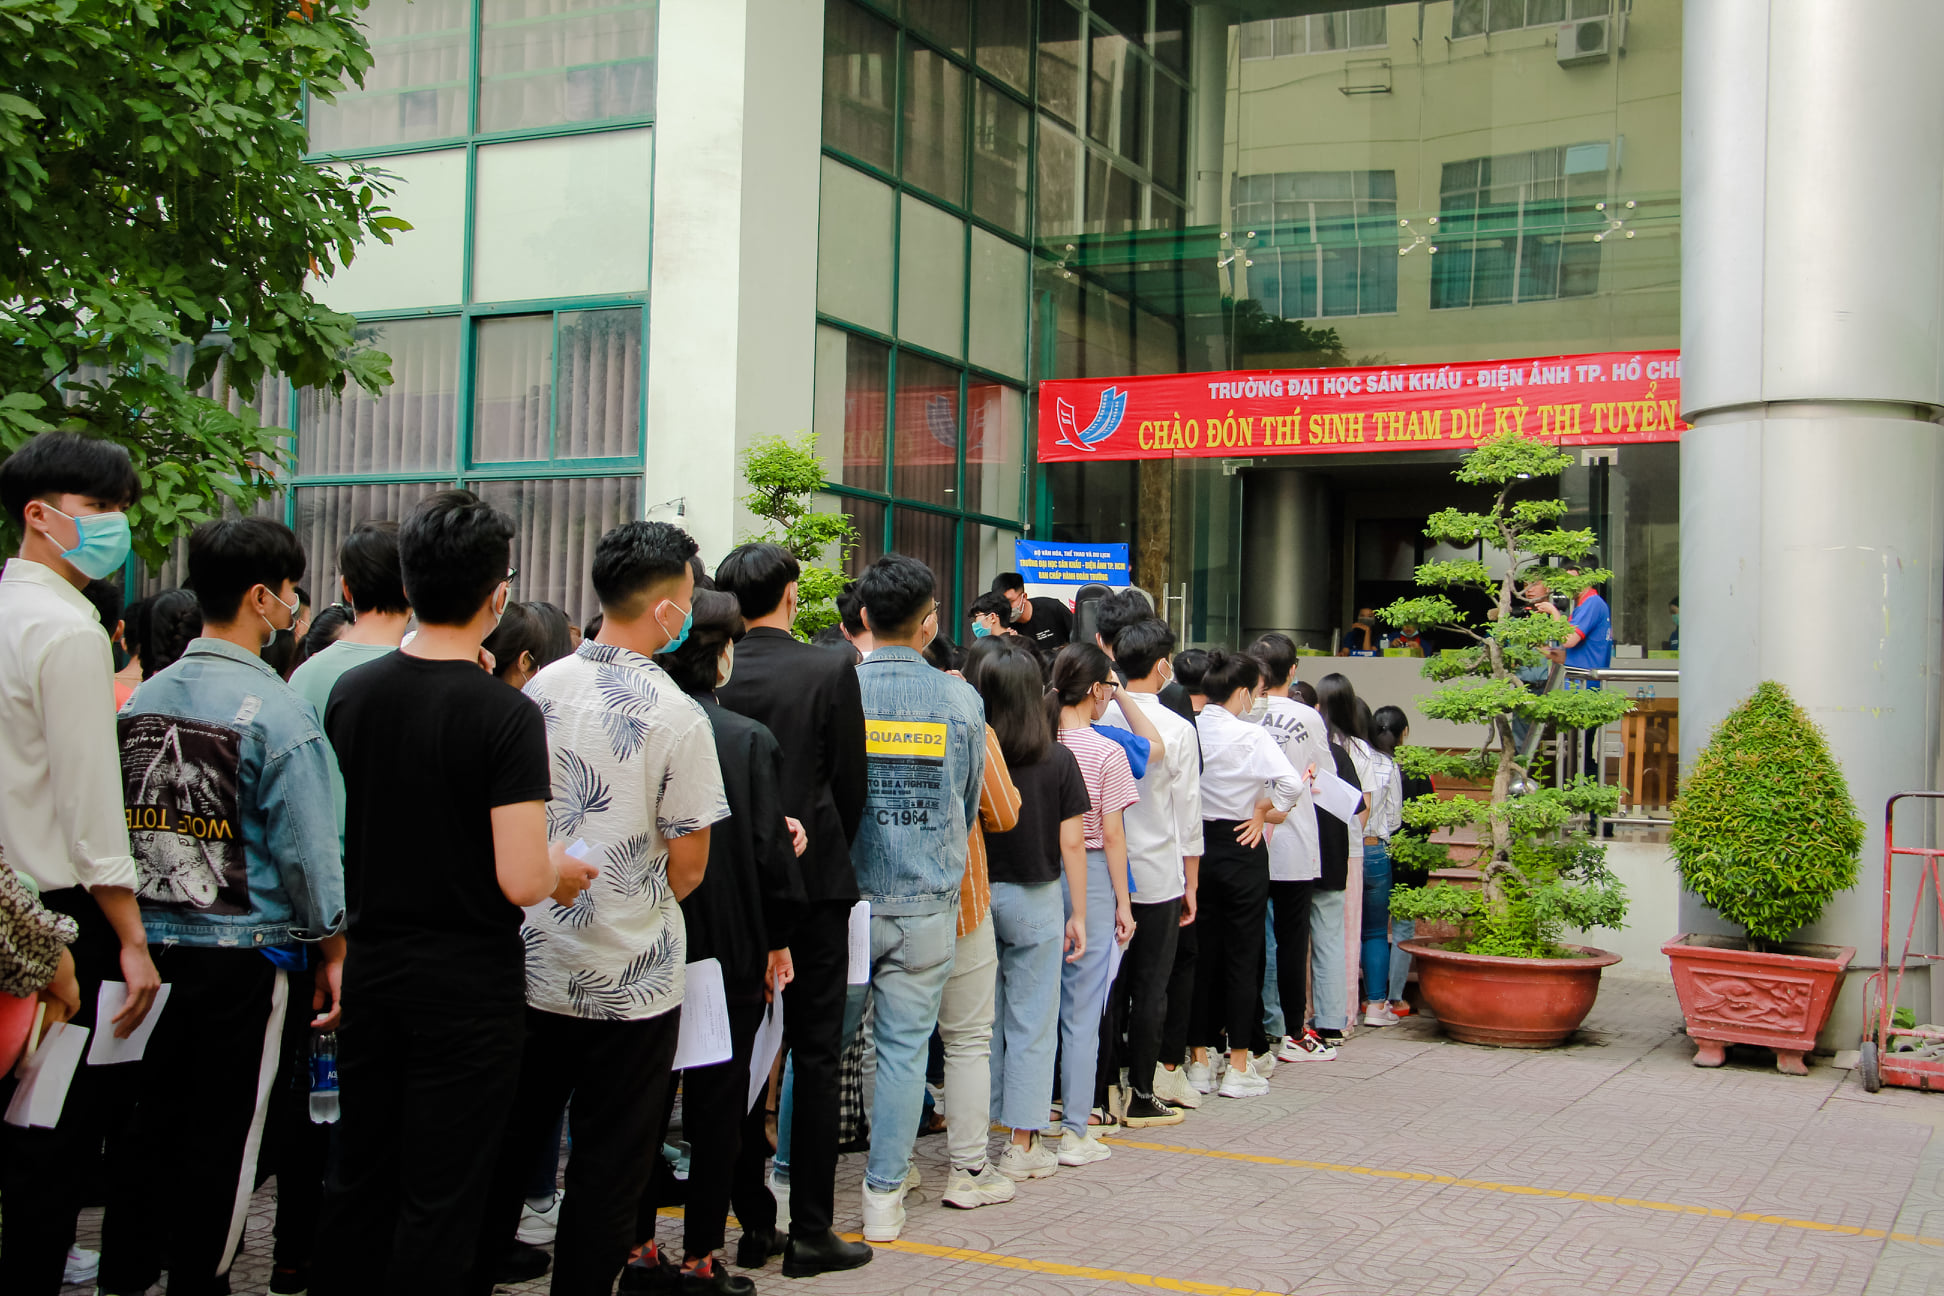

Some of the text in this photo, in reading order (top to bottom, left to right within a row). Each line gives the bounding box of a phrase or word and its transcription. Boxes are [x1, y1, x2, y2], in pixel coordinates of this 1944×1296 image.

[1208, 376, 1283, 399] TRƯỜNG
[1287, 379, 1317, 400] ĐẠI
[1323, 376, 1361, 398] HỌC
[1366, 370, 1403, 393] SÂN
[1408, 366, 1462, 391] KHẤU
[1477, 365, 1523, 392] ĐIỆN
[1528, 362, 1570, 385] ẢNH
[1575, 364, 1606, 383] TP.
[1612, 355, 1642, 381] HỒ
[1138, 411, 1199, 450] CHÀO
[1206, 409, 1254, 448] ĐÓN
[1260, 406, 1302, 446] THÍ
[1308, 412, 1365, 445] SINH
[1372, 409, 1443, 442] THAM
[1493, 397, 1529, 438] KỲ
[1537, 403, 1582, 436] THI
[1589, 381, 1678, 433] TUYỂN
[1261, 712, 1309, 744] ALIFE
[895, 780, 901, 788] A
[904, 780, 941, 789] FIGHTER
